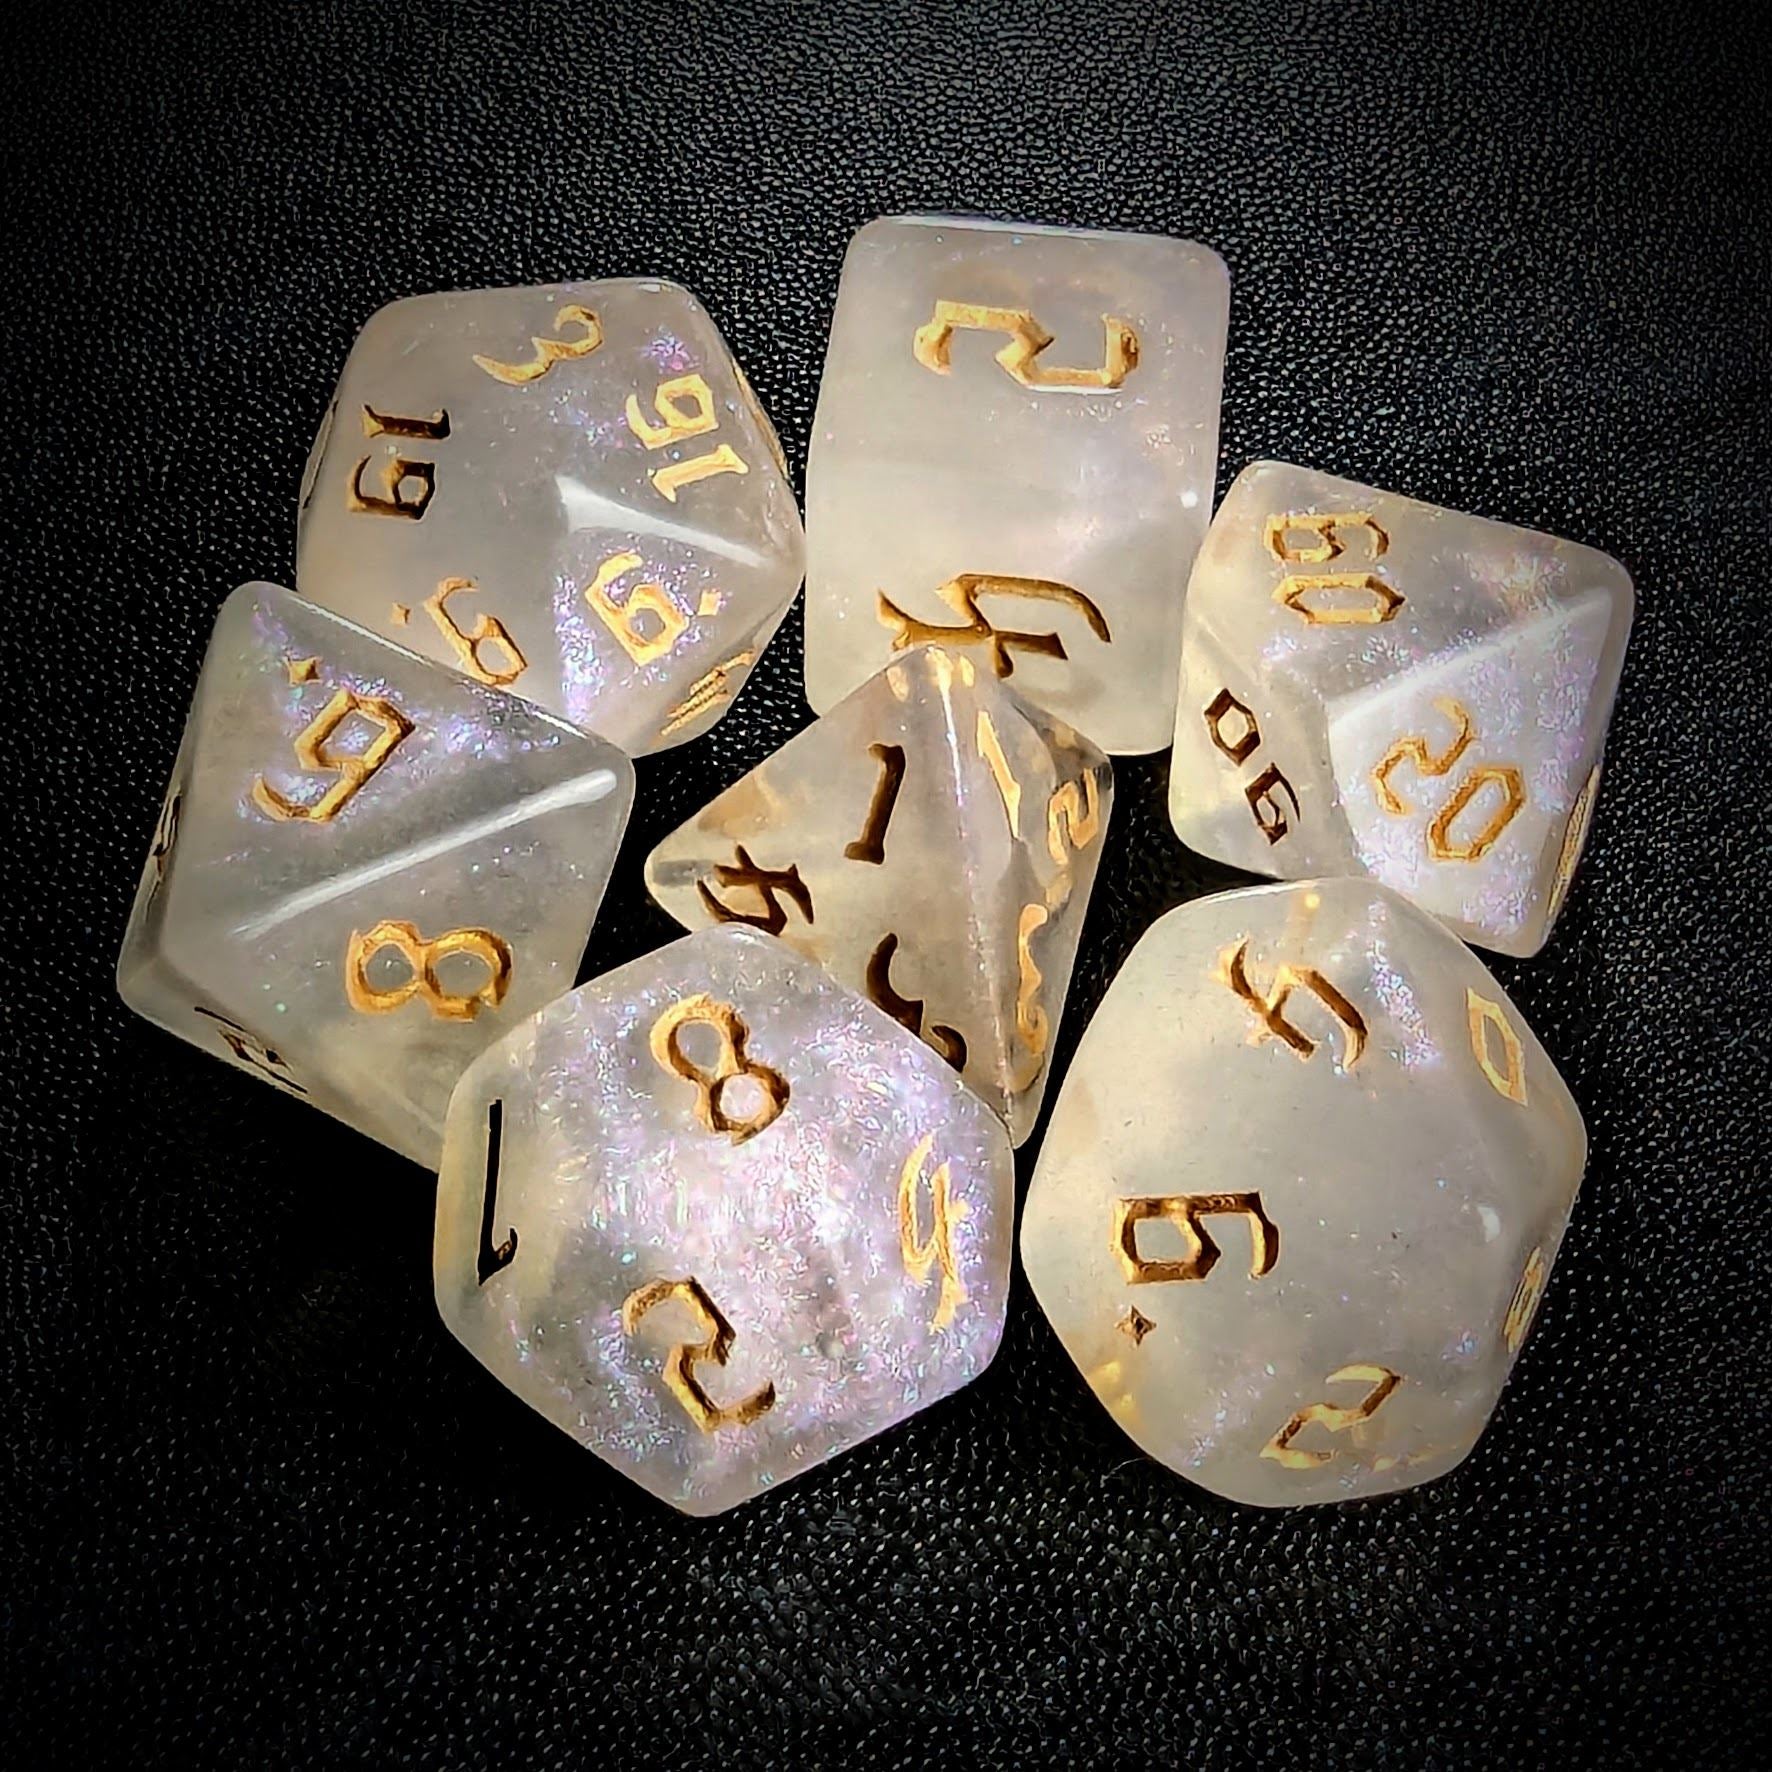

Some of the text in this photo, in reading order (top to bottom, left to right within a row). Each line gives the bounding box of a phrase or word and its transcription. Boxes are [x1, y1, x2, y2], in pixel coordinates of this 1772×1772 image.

[473, 305, 603, 386] 3
[348, 403, 451, 521] 19
[626, 373, 749, 502] 16
[877, 574, 1111, 678] 4
[1263, 511, 1405, 625] 60
[844, 742, 906, 864] 1
[1372, 699, 1527, 863] 20
[697, 844, 814, 935] 4
[346, 919, 513, 1021] 8
[1211, 933, 1368, 1073] 4
[650, 991, 790, 1145] 8
